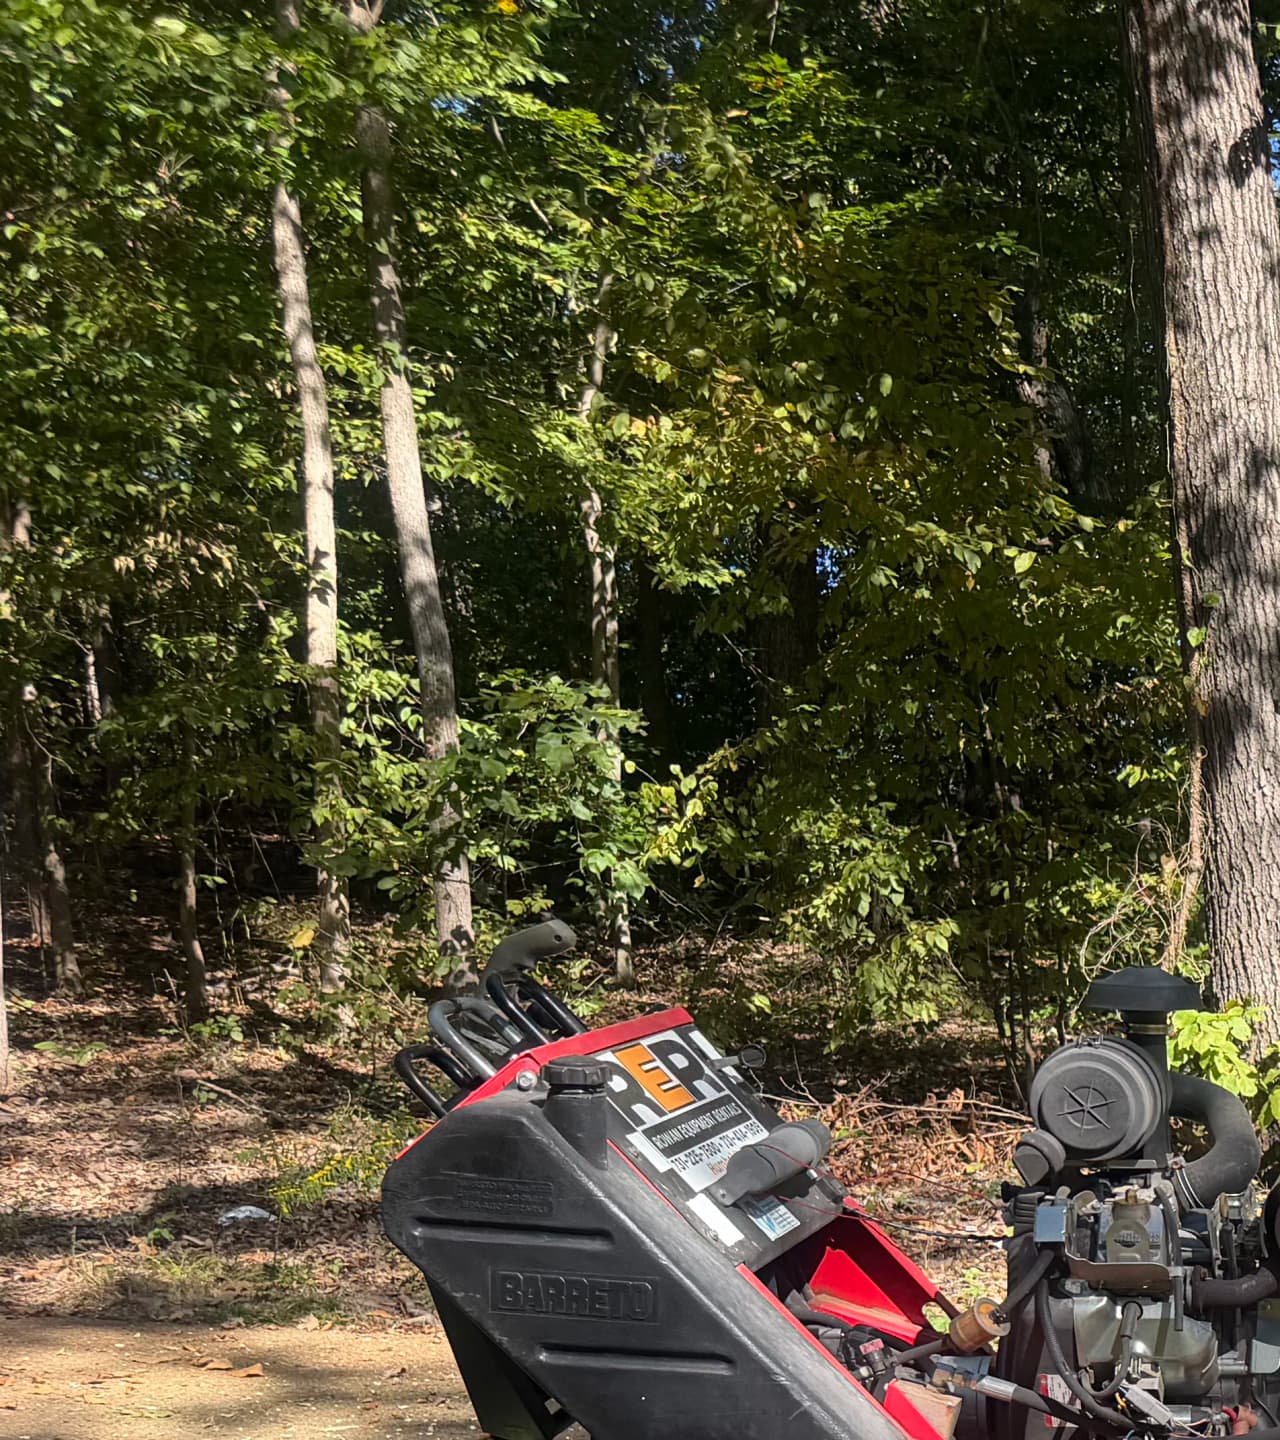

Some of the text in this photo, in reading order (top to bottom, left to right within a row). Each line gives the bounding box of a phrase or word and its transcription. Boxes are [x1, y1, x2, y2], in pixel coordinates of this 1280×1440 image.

[651, 1102, 742, 1149] ROWAN EQUIPMENT RENTALS
[497, 1271, 653, 1321] BARRETO
